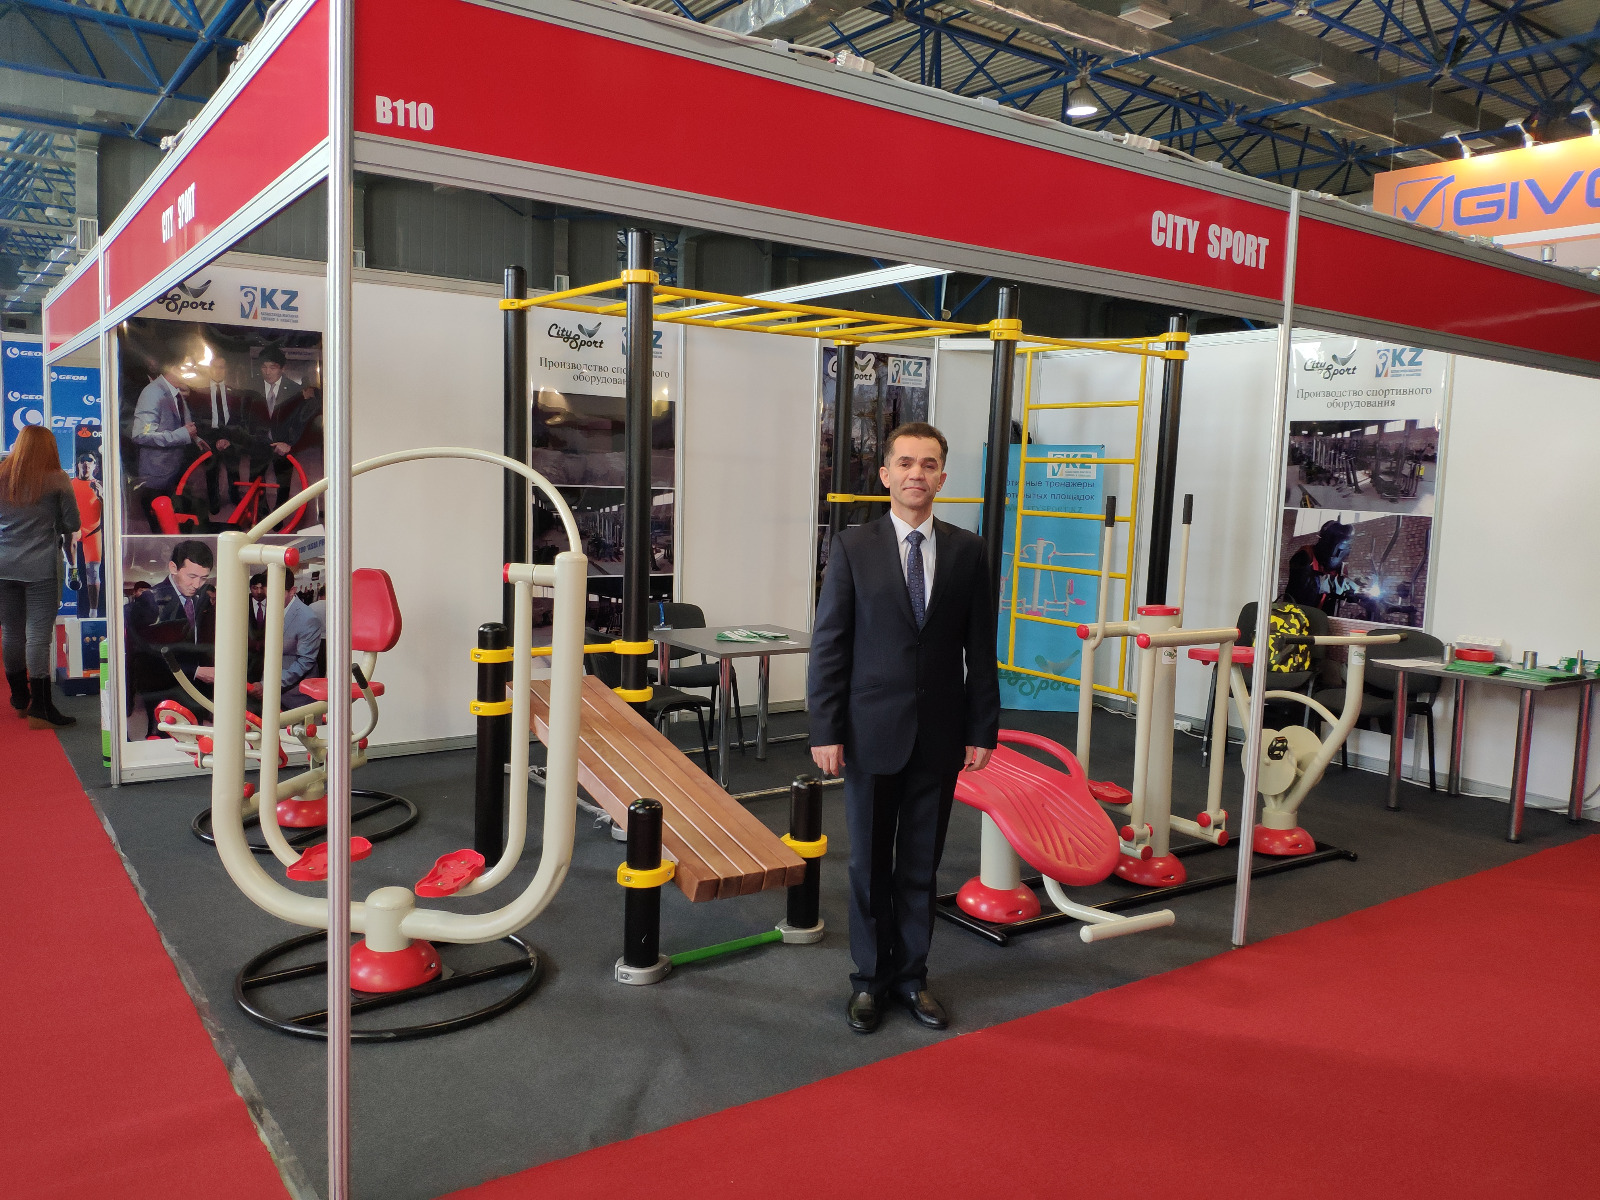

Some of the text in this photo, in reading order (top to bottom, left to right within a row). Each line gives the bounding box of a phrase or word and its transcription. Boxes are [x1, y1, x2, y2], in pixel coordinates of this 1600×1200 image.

[375, 95, 434, 131] B110
[1453, 167, 1600, 226] GIV
[161, 181, 196, 244] CITY SPORT
[1151, 210, 1270, 270] CITY SPORT
[260, 287, 299, 312] KZ
[548, 323, 604, 352] City Sport
[652, 330, 663, 349] Z
[1391, 347, 1424, 368] KZ
[572, 371, 627, 385] оборудован
[902, 360, 923, 377] KZ
[1296, 387, 1432, 400] Производство спортивного
[1326, 398, 1396, 411] оборудования
[1051, 493, 1095, 502] площадок
